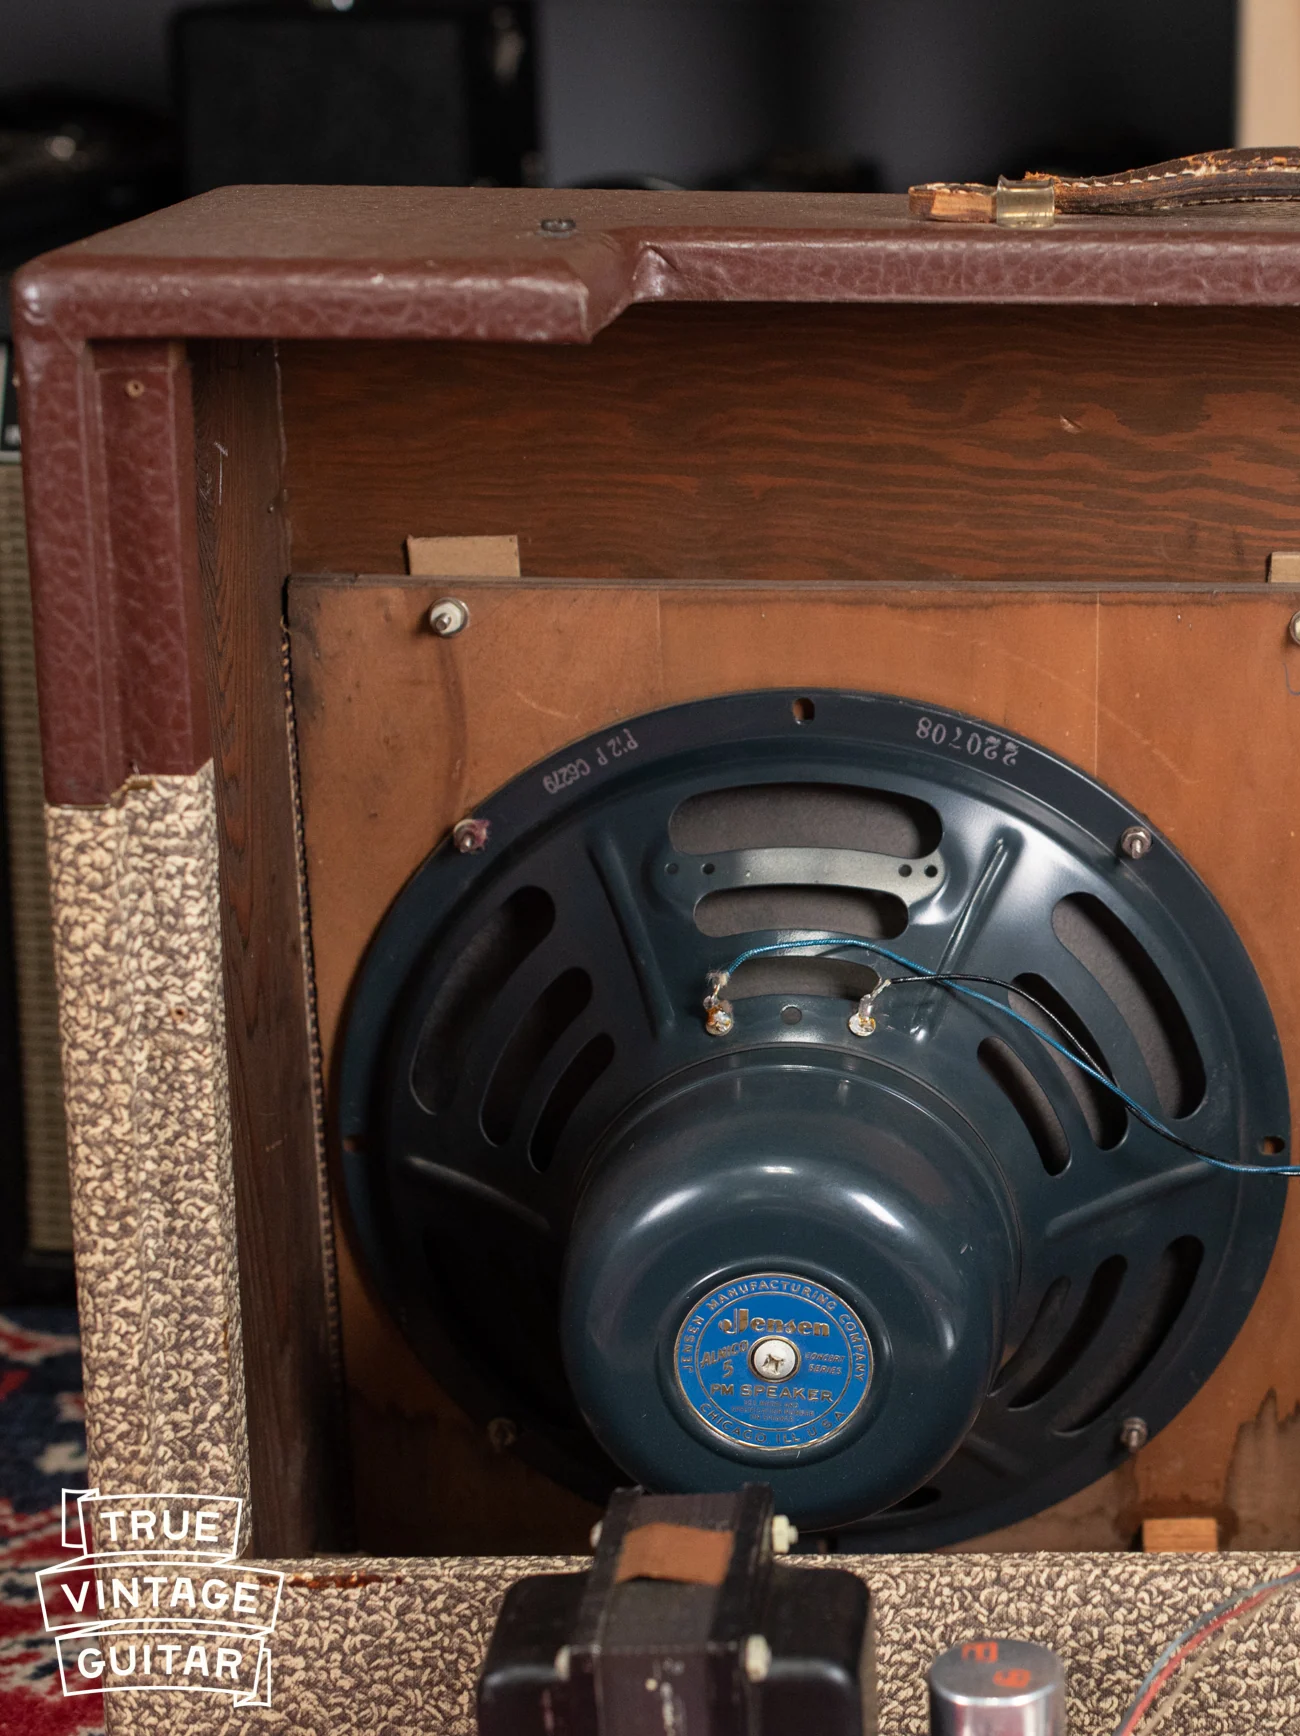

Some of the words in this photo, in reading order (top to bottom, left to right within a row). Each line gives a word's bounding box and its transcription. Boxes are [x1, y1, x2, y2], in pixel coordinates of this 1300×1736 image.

[916, 717, 1019, 766] 220708
[543, 758, 591, 795] C6279
[681, 1315, 705, 1373] JENSEN
[706, 1280, 838, 1311] MANUFACTURING
[839, 1314, 867, 1382] COMPANY
[718, 1308, 830, 1337] Jensen
[700, 1340, 750, 1369] ALNICO
[722, 1359, 734, 1378] 5
[804, 1352, 846, 1364] CONCERT
[808, 1364, 843, 1375] SERIES
[710, 1383, 734, 1396] PM
[740, 1385, 833, 1403] SPEAKER
